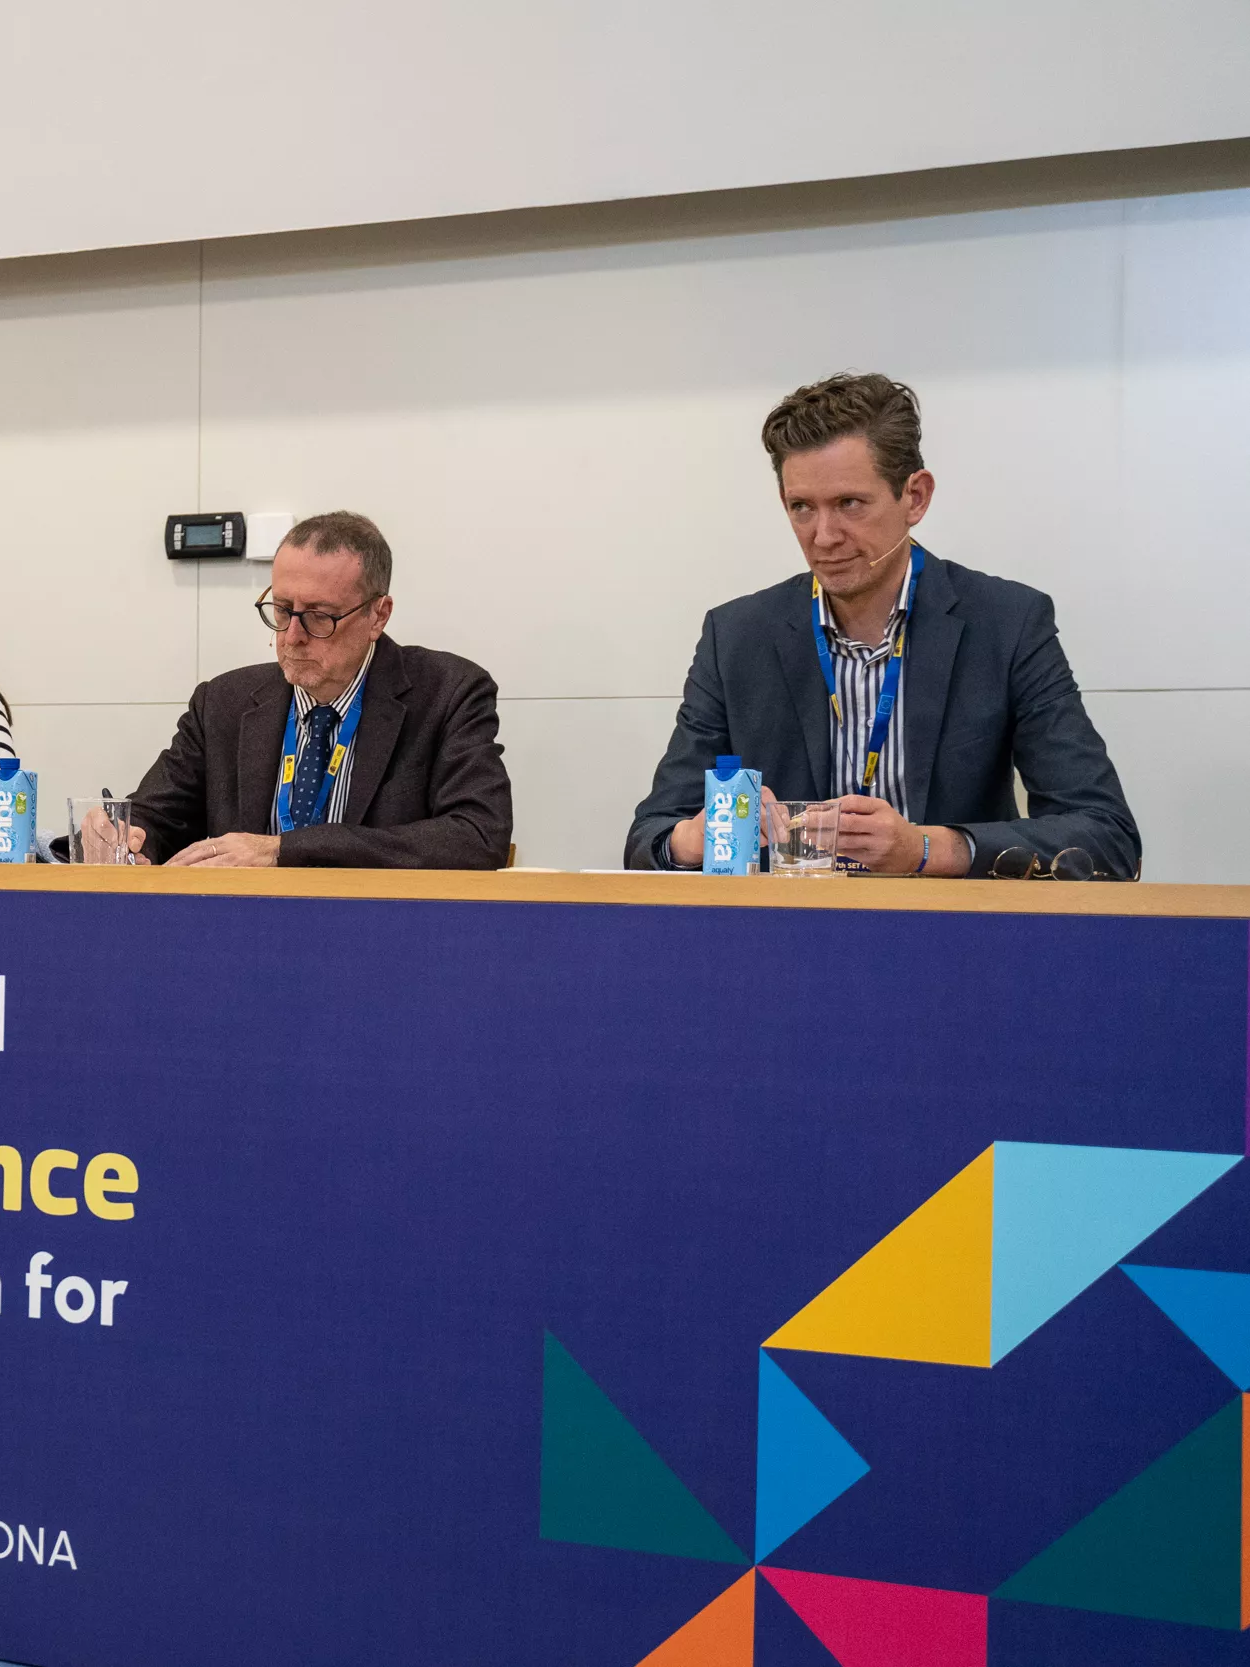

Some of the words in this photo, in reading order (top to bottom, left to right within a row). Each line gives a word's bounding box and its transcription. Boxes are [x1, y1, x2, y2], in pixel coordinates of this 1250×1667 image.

[707, 792, 733, 862] aqua
[711, 866, 735, 875] aqualy
[25, 1251, 129, 1327] for
